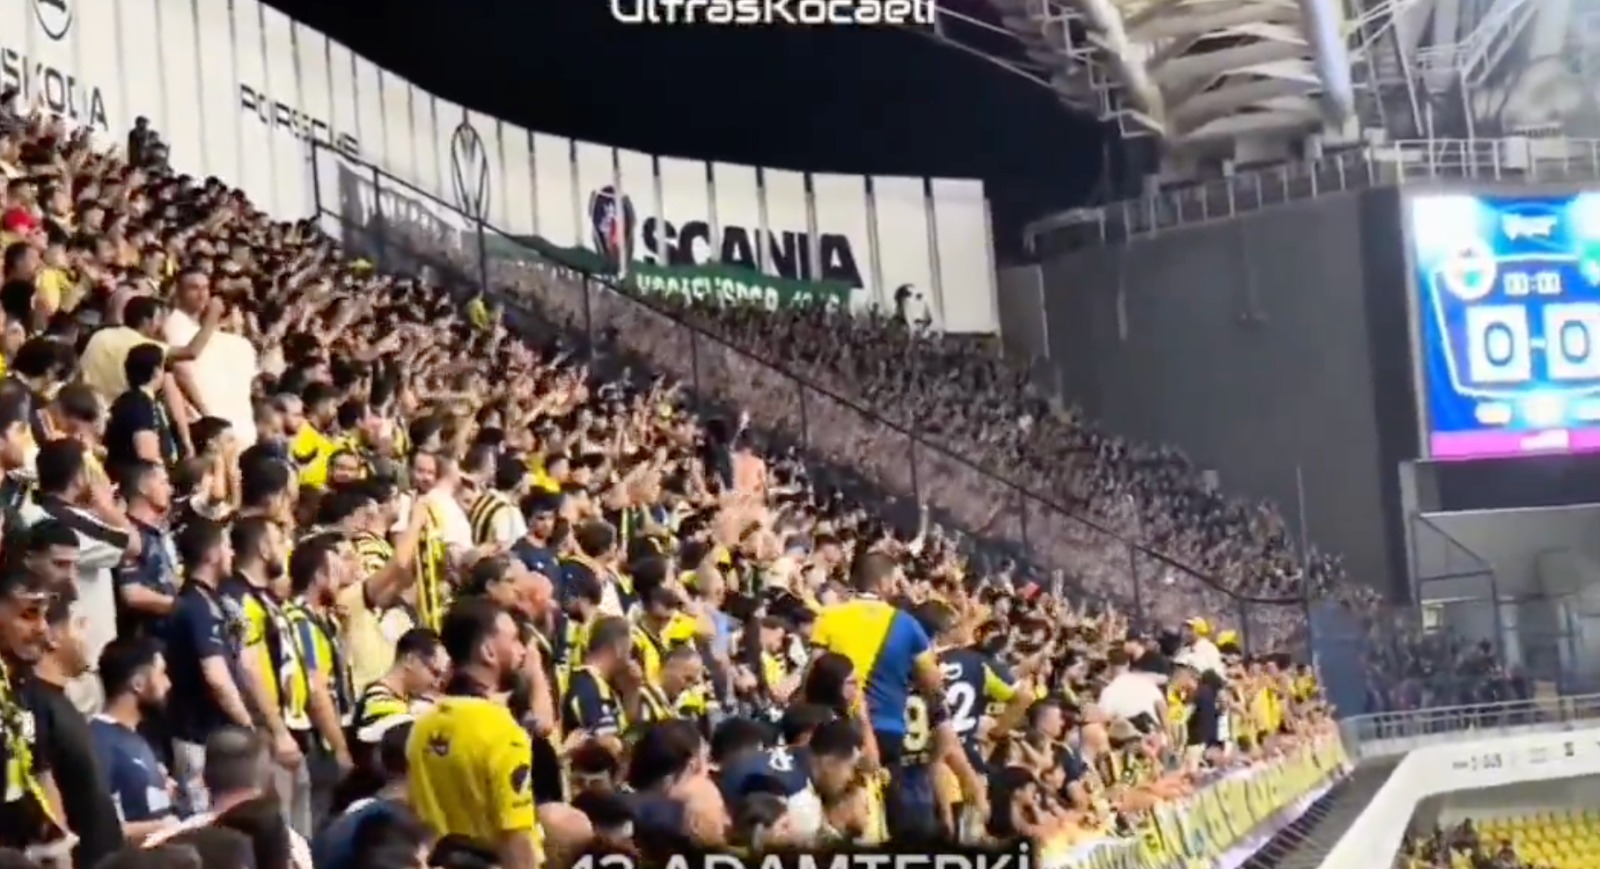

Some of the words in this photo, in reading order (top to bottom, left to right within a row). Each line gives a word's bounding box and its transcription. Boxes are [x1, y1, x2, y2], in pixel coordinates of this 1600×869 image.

[642, 216, 864, 289] SCANIA
[1484, 321, 1515, 367] 0
[1559, 319, 1590, 364] 0
